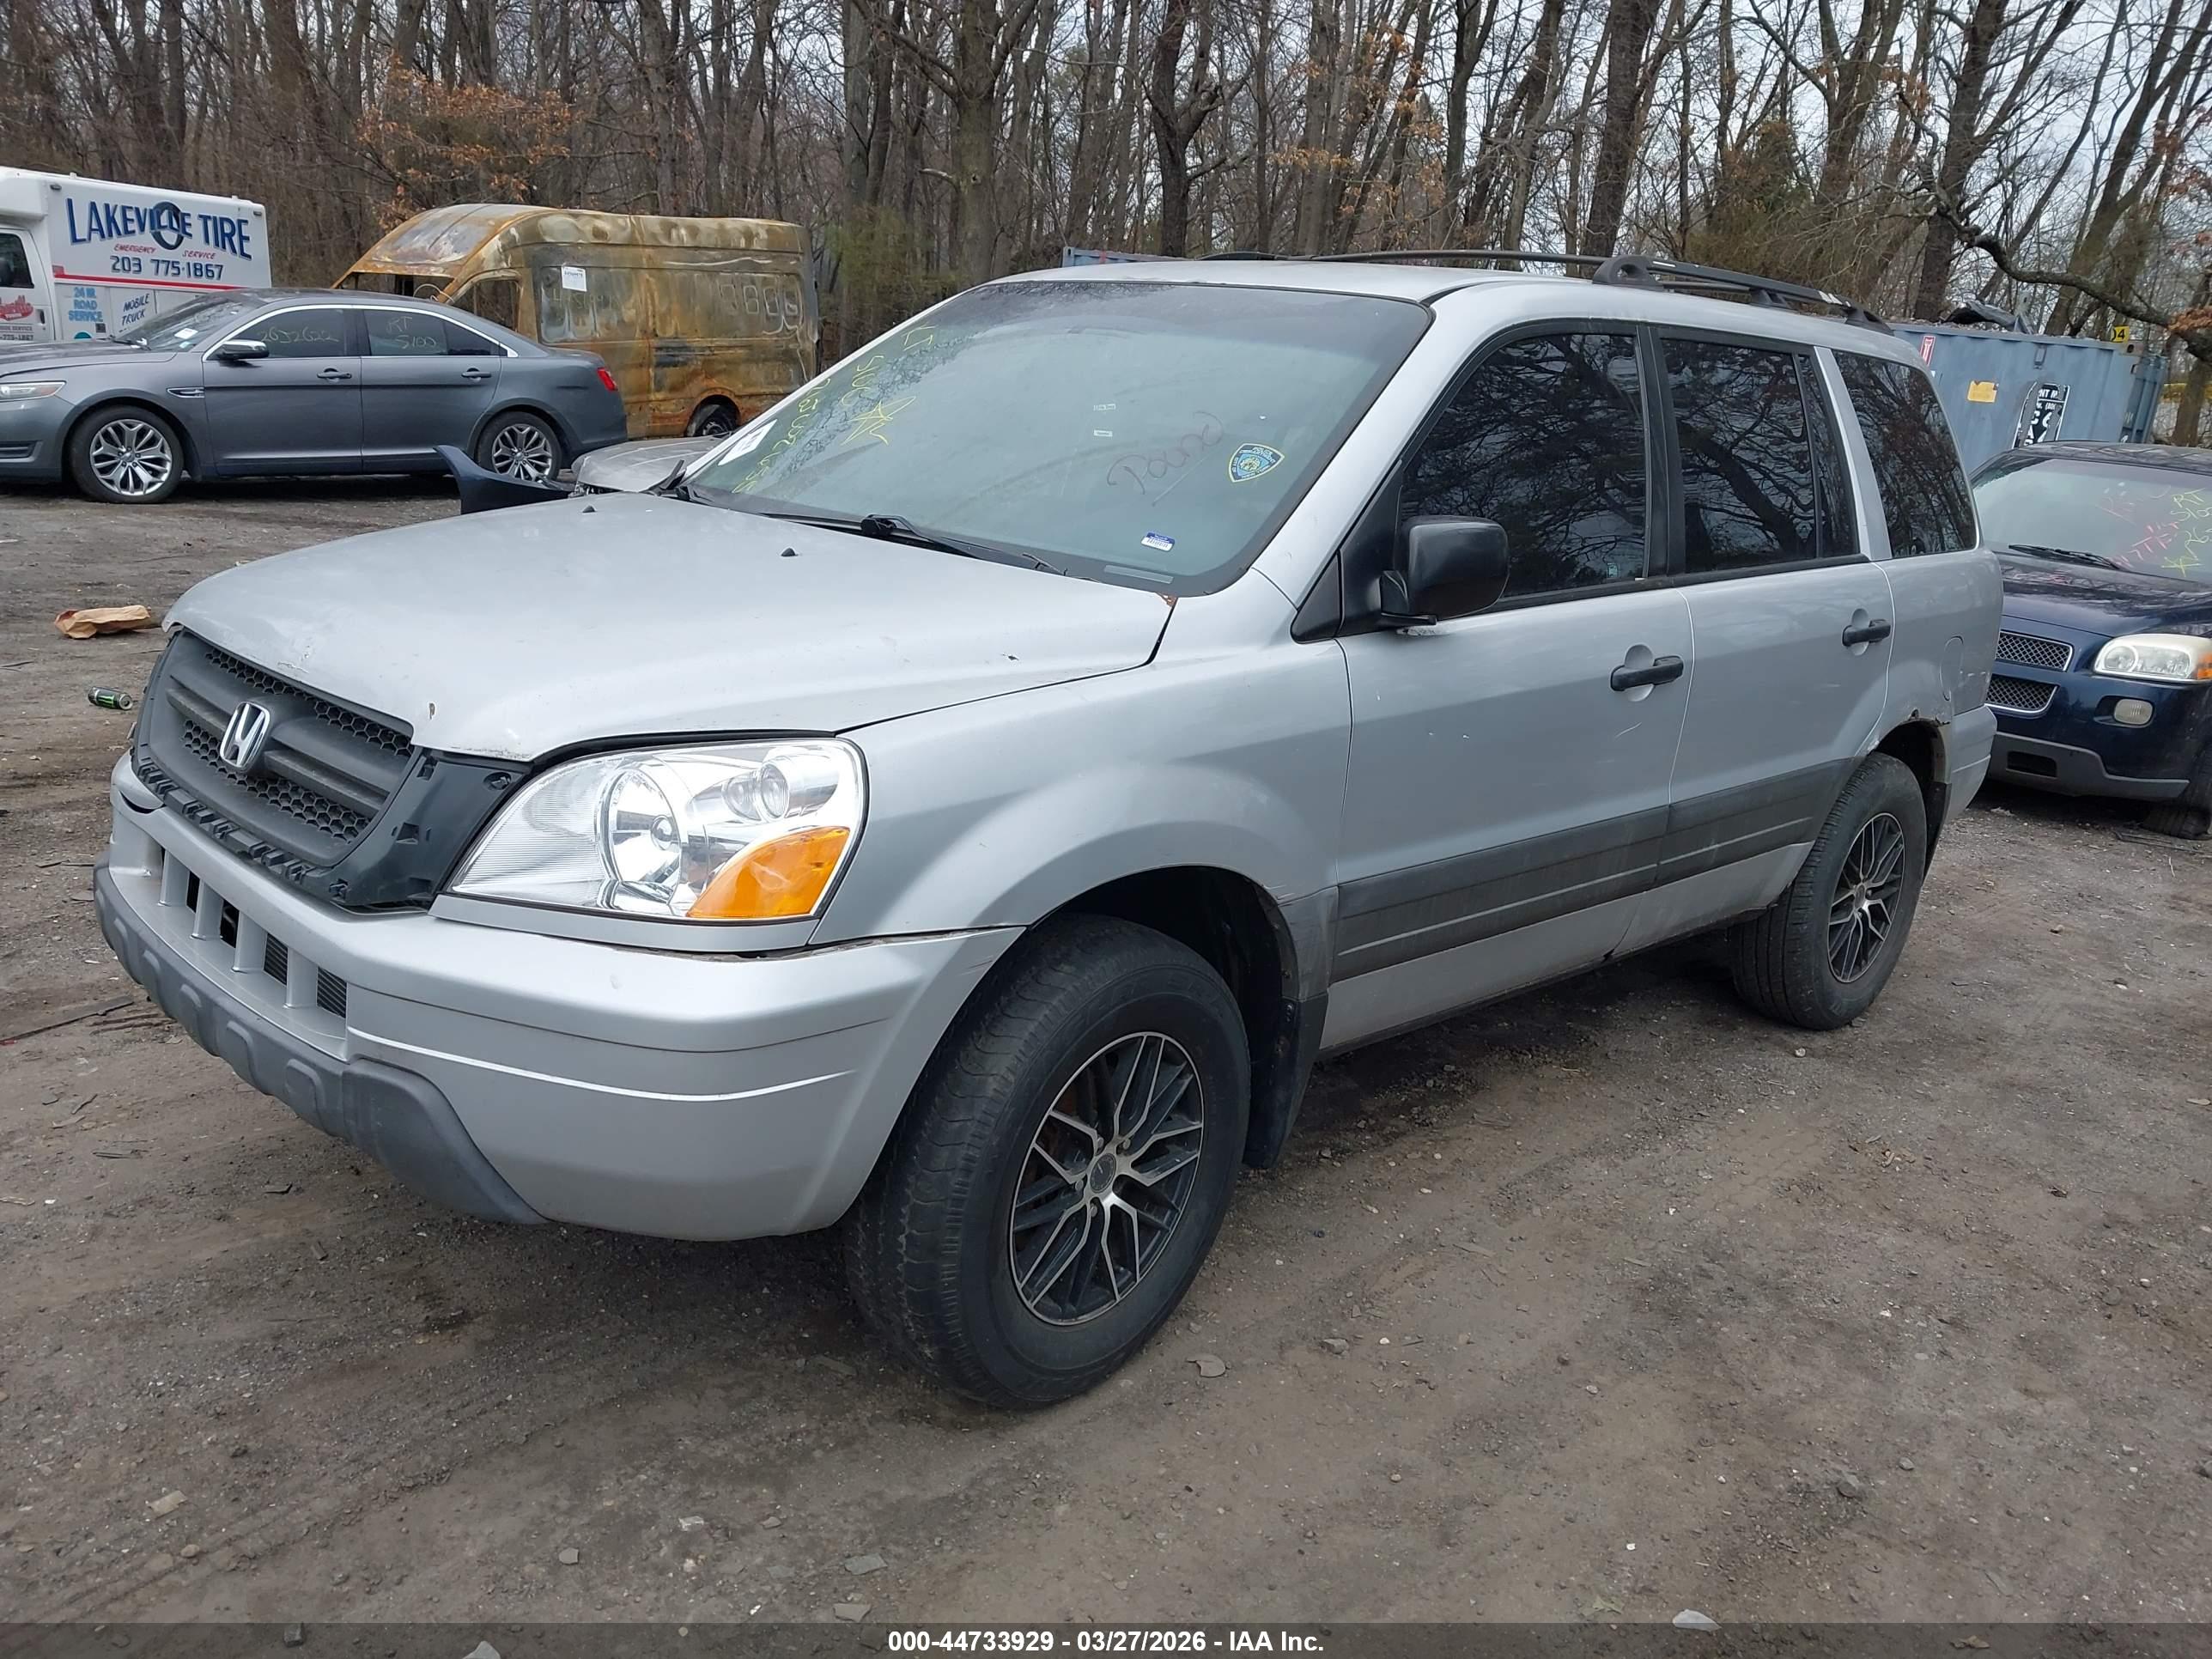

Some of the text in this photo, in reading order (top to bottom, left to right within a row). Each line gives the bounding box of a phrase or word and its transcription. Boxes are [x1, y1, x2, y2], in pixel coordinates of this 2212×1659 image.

[66, 198, 252, 261] LAKEVILLE TIRE
[113, 243, 216, 260] EMERGENCY SERVICE
[110, 255, 142, 275] 203
[74, 287, 85, 298] 24
[74, 300, 98, 310] ROAD
[123, 293, 150, 313] MOBILE
[68, 311, 103, 322] SERVICE
[121, 309, 146, 325] TRUCK
